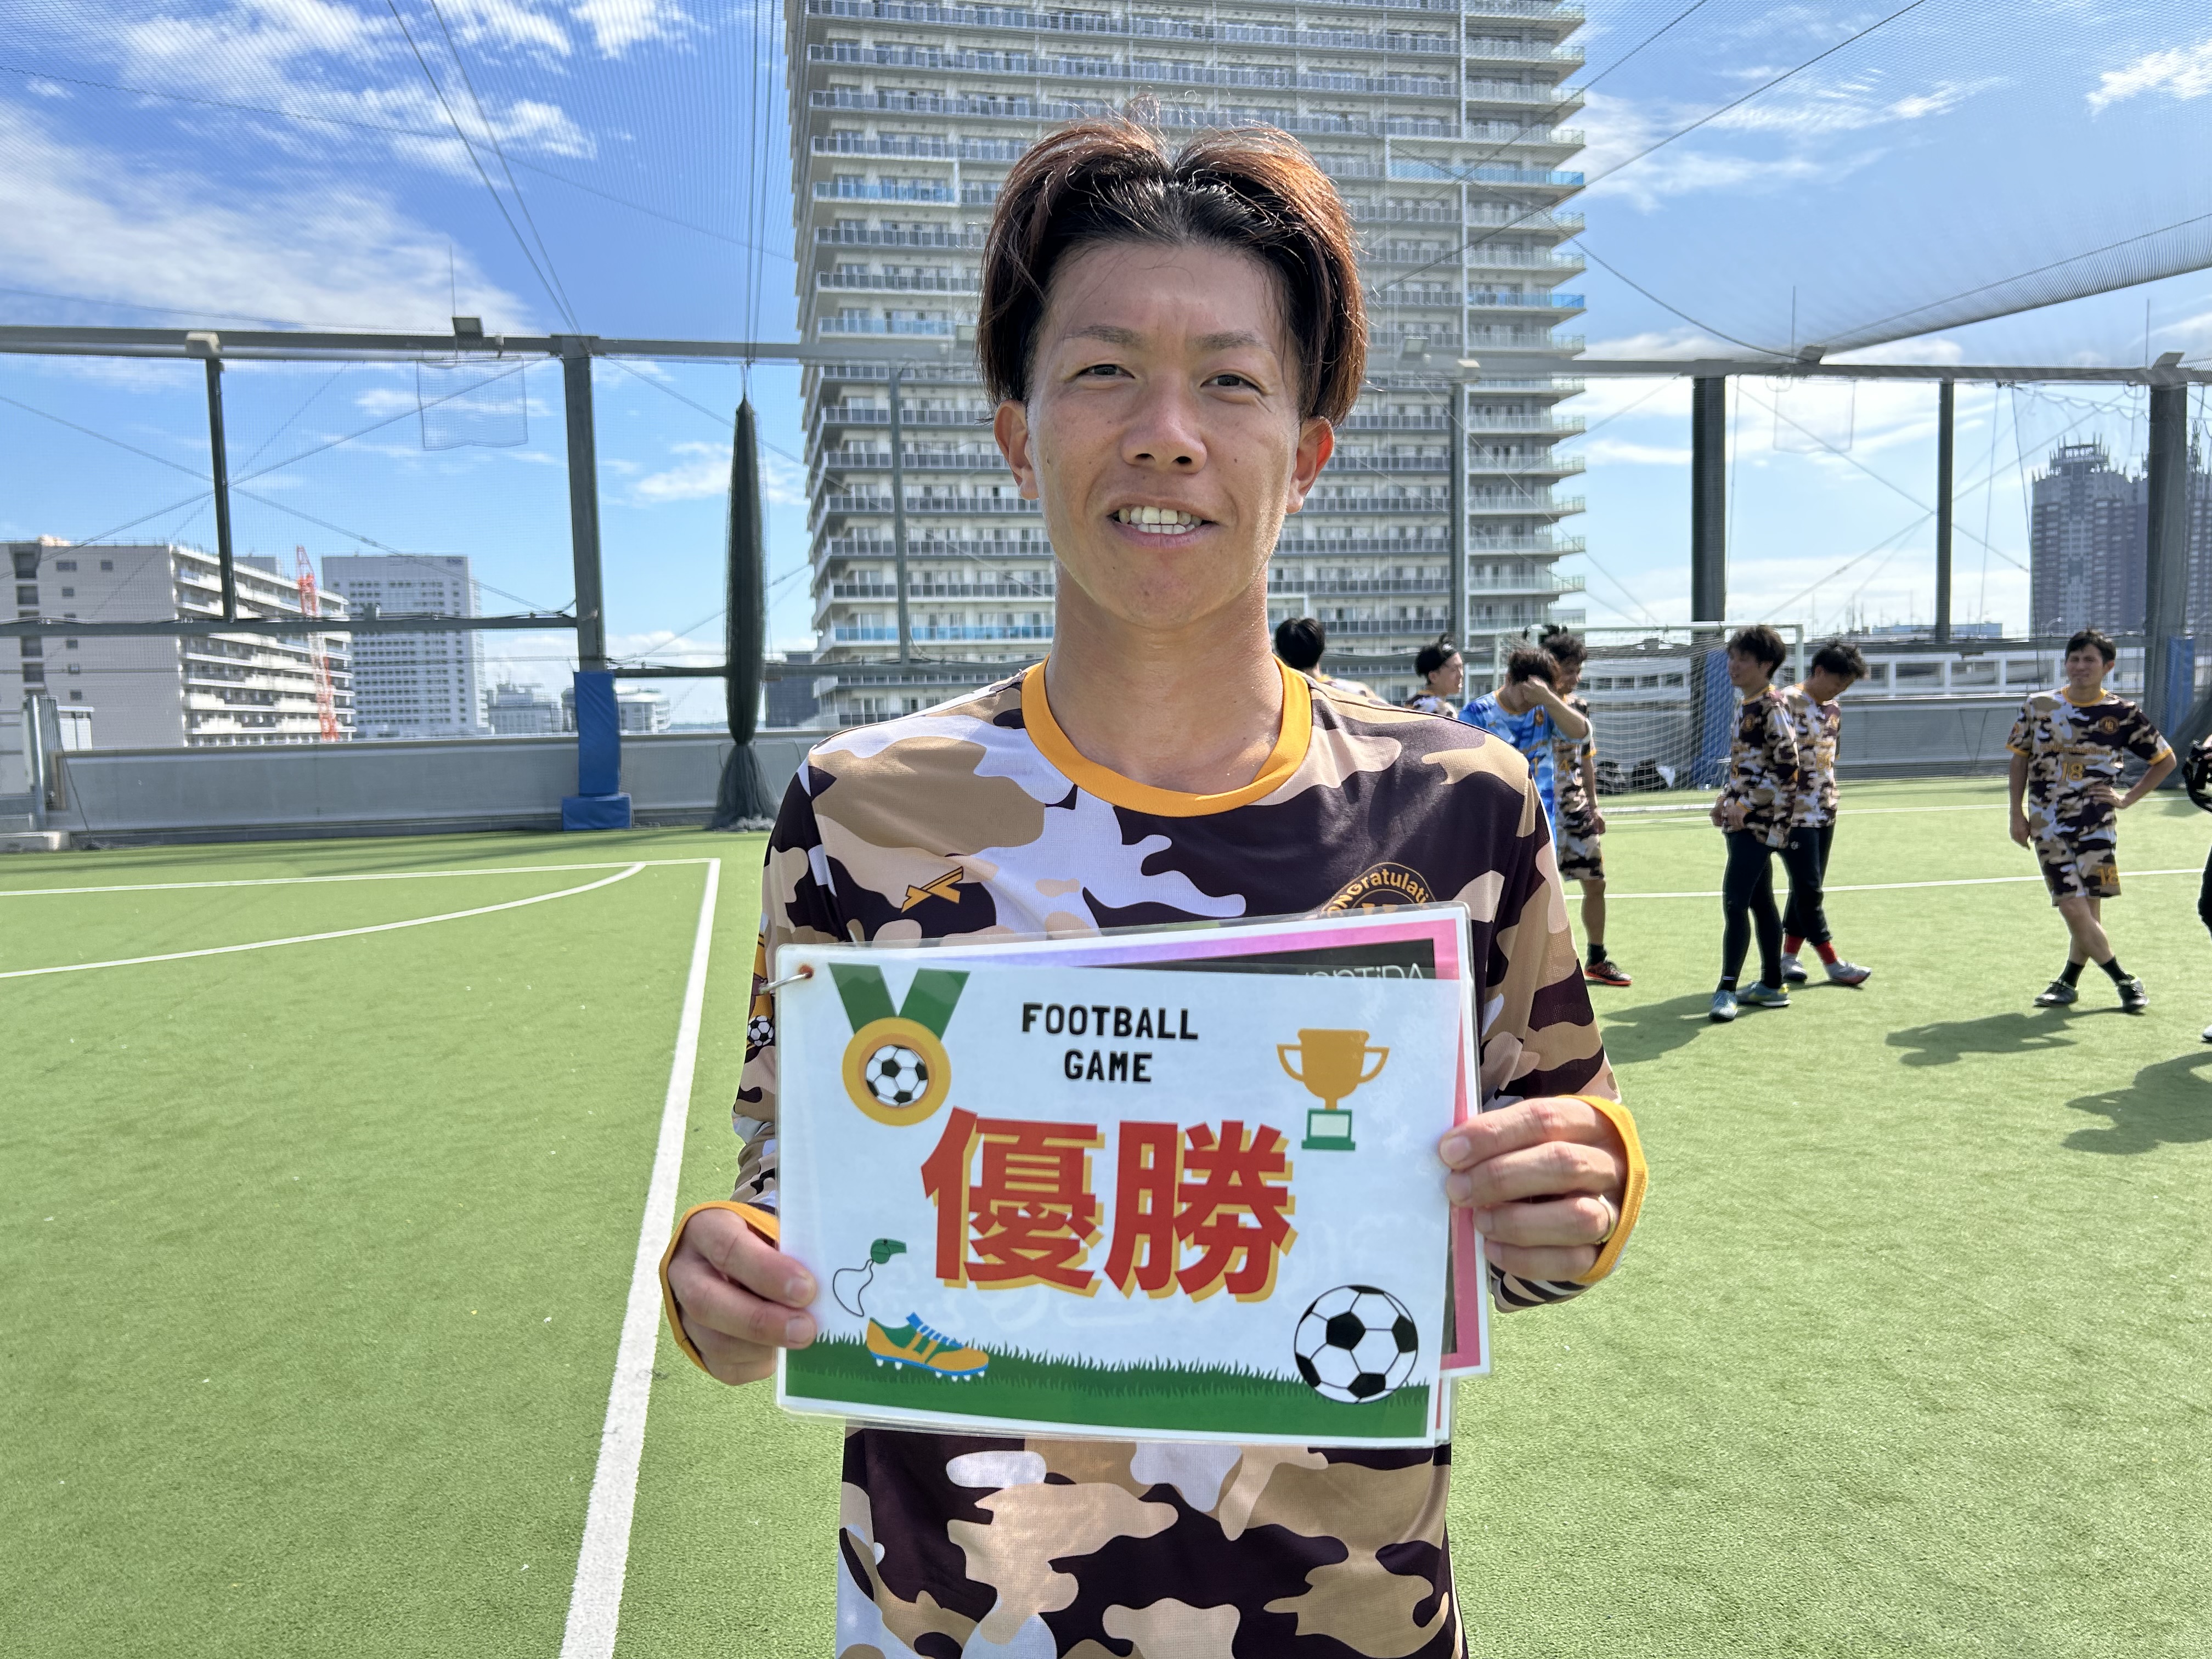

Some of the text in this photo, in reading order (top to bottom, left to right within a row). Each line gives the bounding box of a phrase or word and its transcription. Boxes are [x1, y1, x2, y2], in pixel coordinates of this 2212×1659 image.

[2061, 761, 2084, 782] 18
[2098, 866, 2119, 886] 18
[1022, 1002, 1199, 1040] FOOTBALL
[1064, 1048, 1153, 1082] GAME
[921, 1106, 1298, 1302] 優勝
